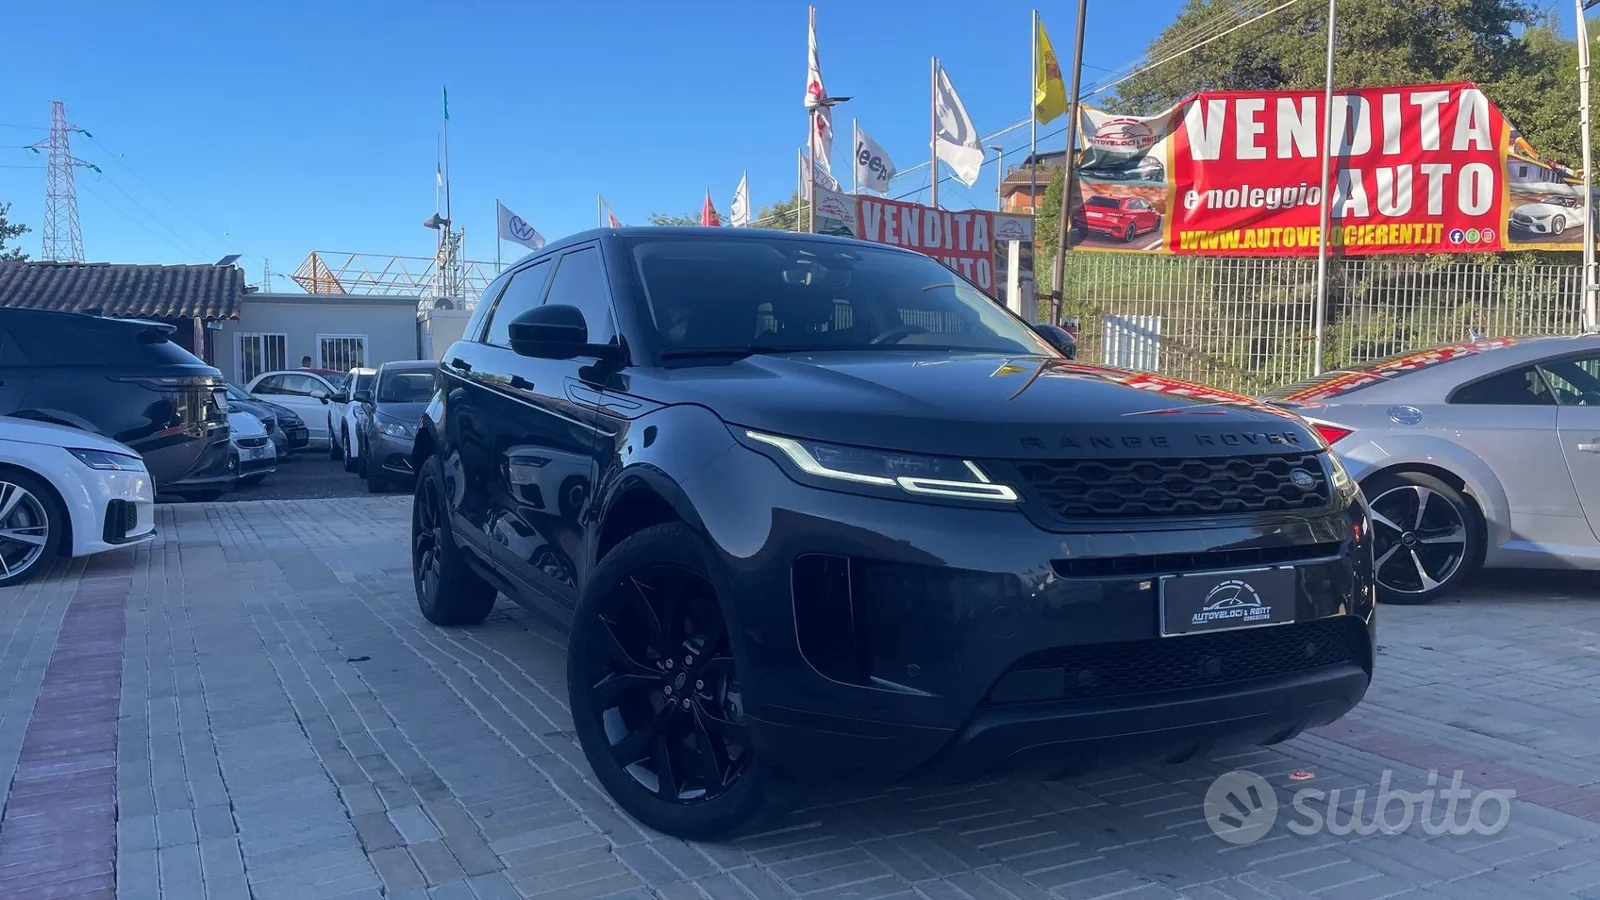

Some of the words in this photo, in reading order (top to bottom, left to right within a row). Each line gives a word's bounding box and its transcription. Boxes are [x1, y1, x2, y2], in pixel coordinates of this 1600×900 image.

[1183, 88, 1493, 161] VENDITA
[1184, 188, 1200, 209] e
[1207, 183, 1321, 210] noleggio
[1331, 162, 1494, 218] AUTO
[861, 200, 990, 252] VENDITA
[1018, 435, 1172, 450] RANGE
[1195, 431, 1301, 447] ROVER
[1192, 609, 1243, 621] AUTOVELOCI
[1249, 606, 1272, 615] RENT
